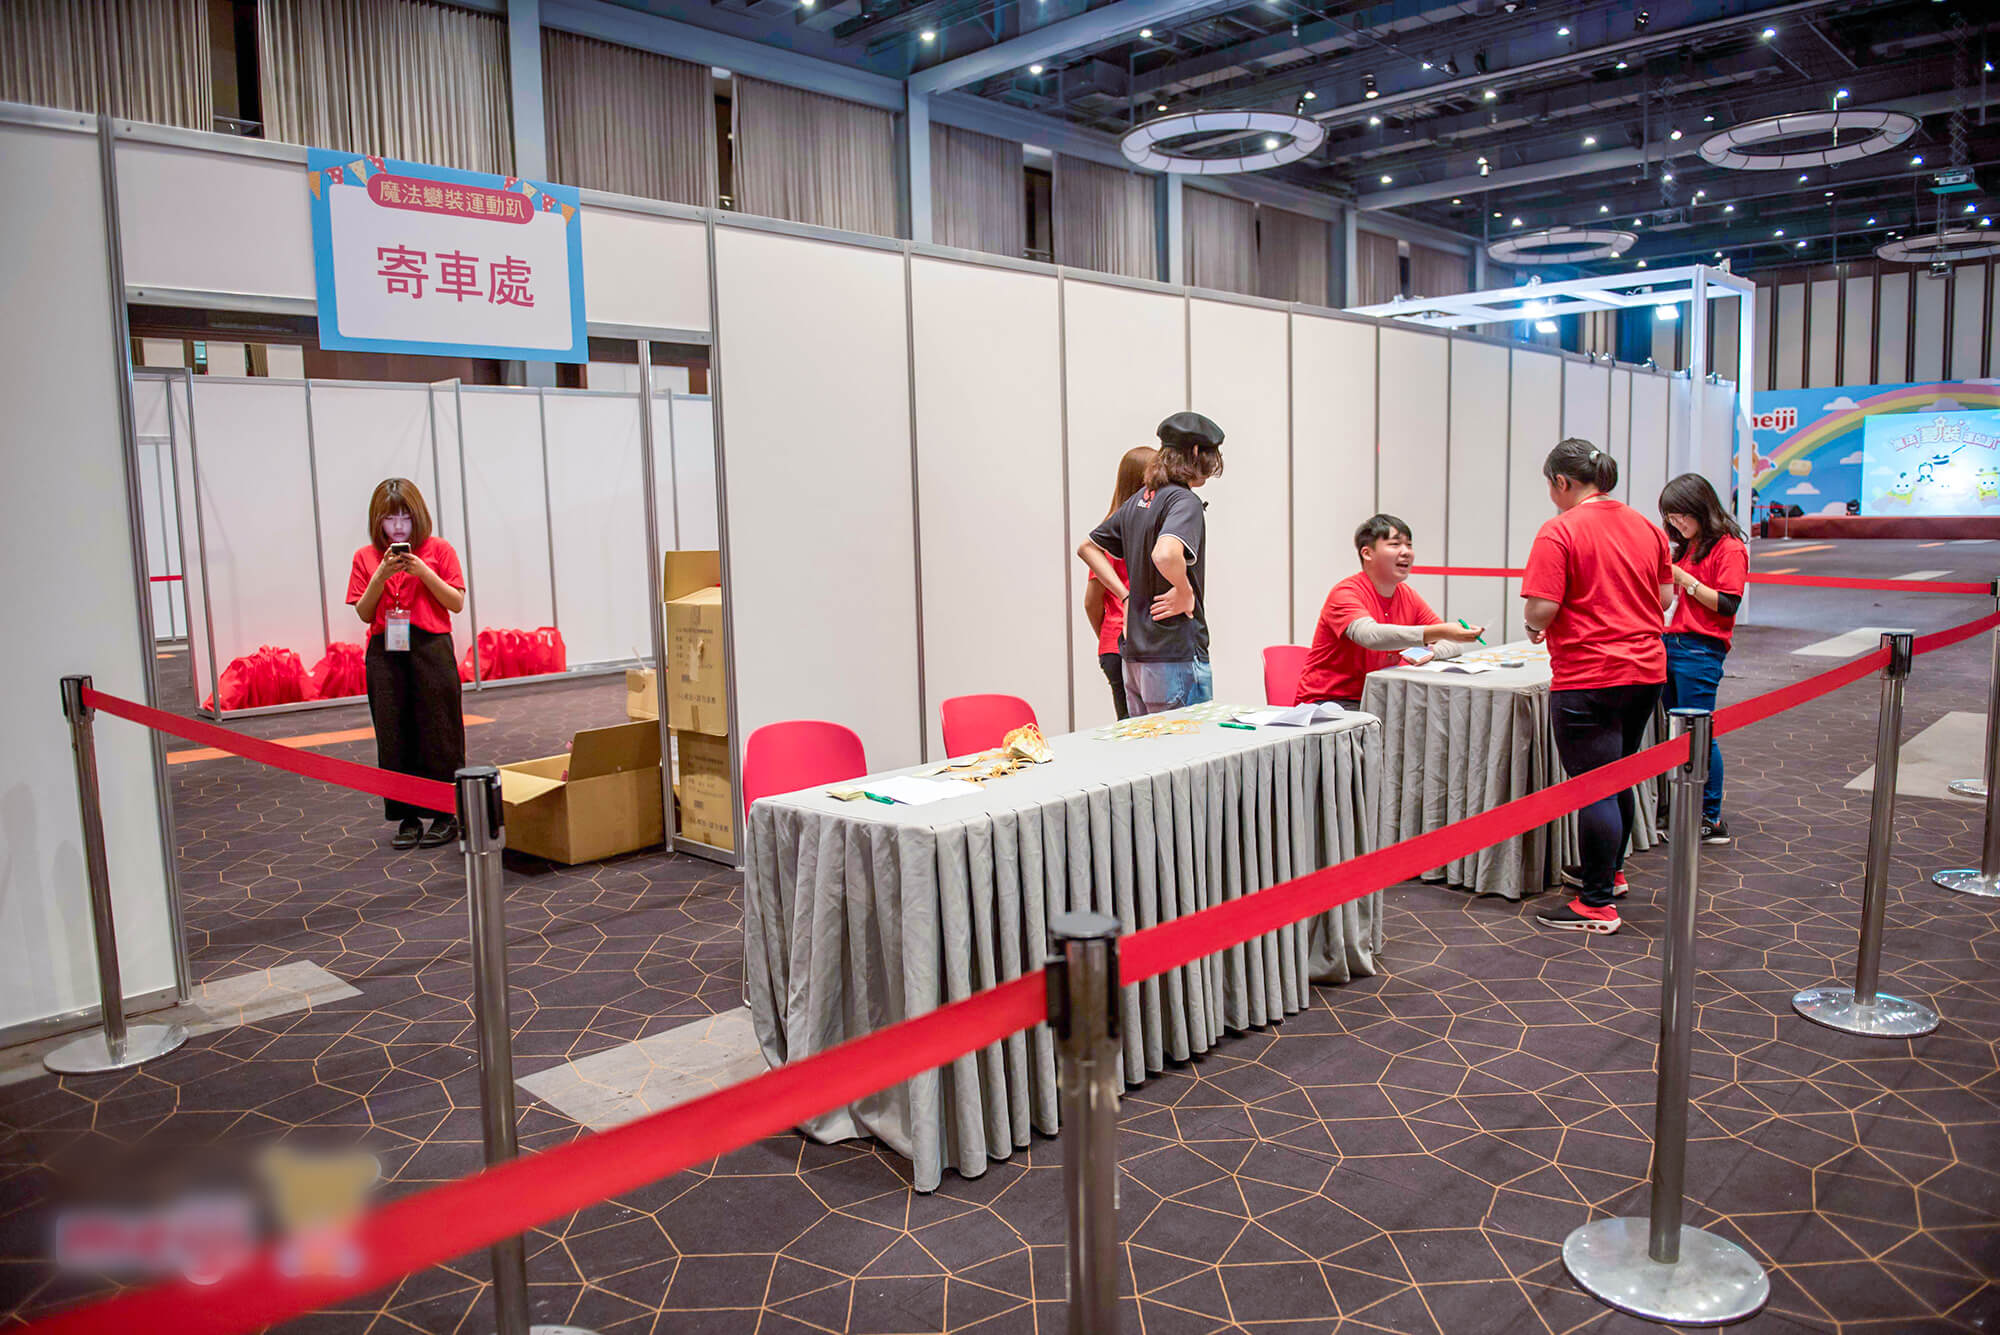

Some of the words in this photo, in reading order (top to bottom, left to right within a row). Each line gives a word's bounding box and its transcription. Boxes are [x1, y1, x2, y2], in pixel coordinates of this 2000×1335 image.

[379, 180, 525, 219] 魔法變裝運動趴
[376, 244, 535, 308] 寄車處
